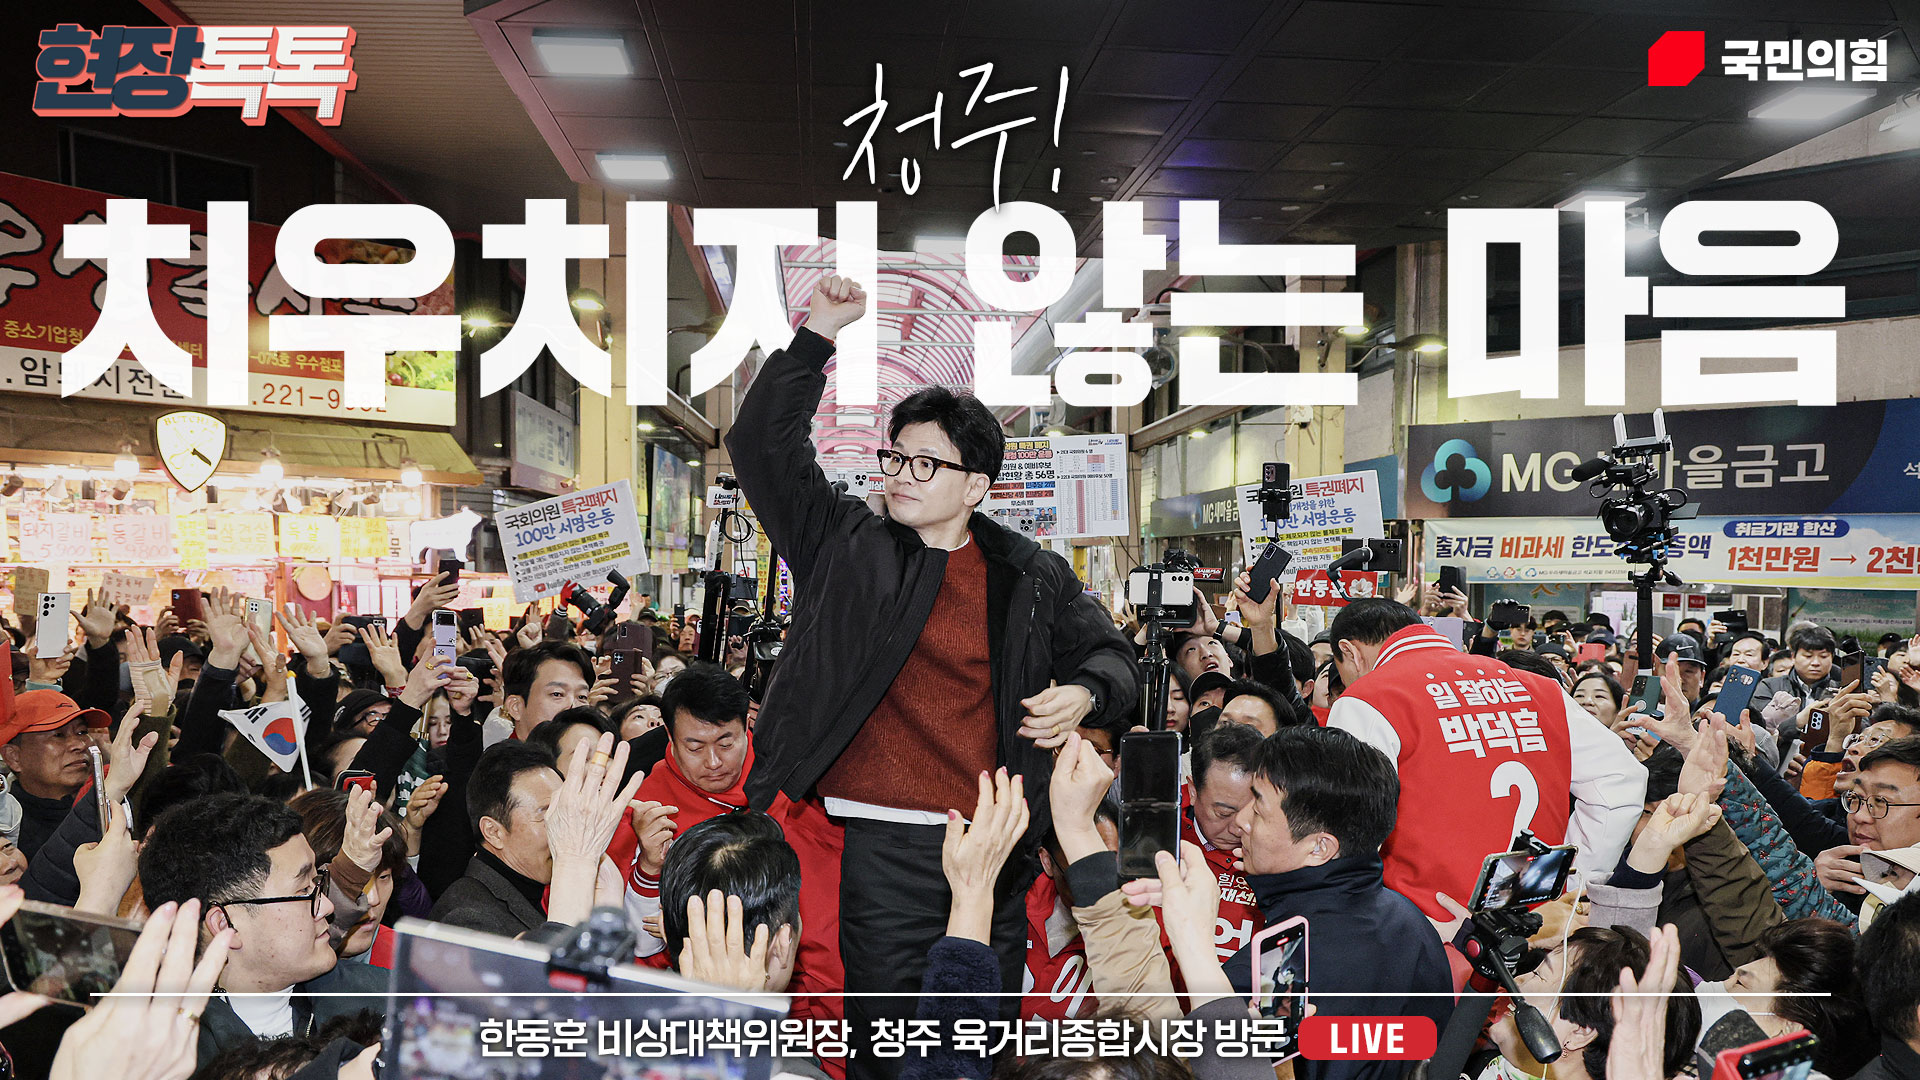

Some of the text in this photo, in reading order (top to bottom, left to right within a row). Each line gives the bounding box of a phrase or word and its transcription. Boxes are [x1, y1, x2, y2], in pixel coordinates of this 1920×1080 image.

[1035, 470, 1055, 479] 56명
[1305, 477, 1365, 498] 특권폐지
[504, 488, 618, 530] 국회의원 특권폐지
[1318, 498, 1335, 508] 위한
[515, 507, 615, 547] 100만 서명운동
[1260, 507, 1357, 531] 10만 서명운동
[1734, 520, 1836, 537] 취급기관 합산
[22, 522, 89, 542] 돼지갈비
[1436, 536, 1494, 559] 출자금
[1499, 535, 1565, 559] 비과세
[1727, 546, 1821, 573] 1천만원
[1425, 677, 1532, 709] 일 잘하는
[1438, 708, 1548, 759] 박덕흠
[1490, 760, 1540, 853] 2
